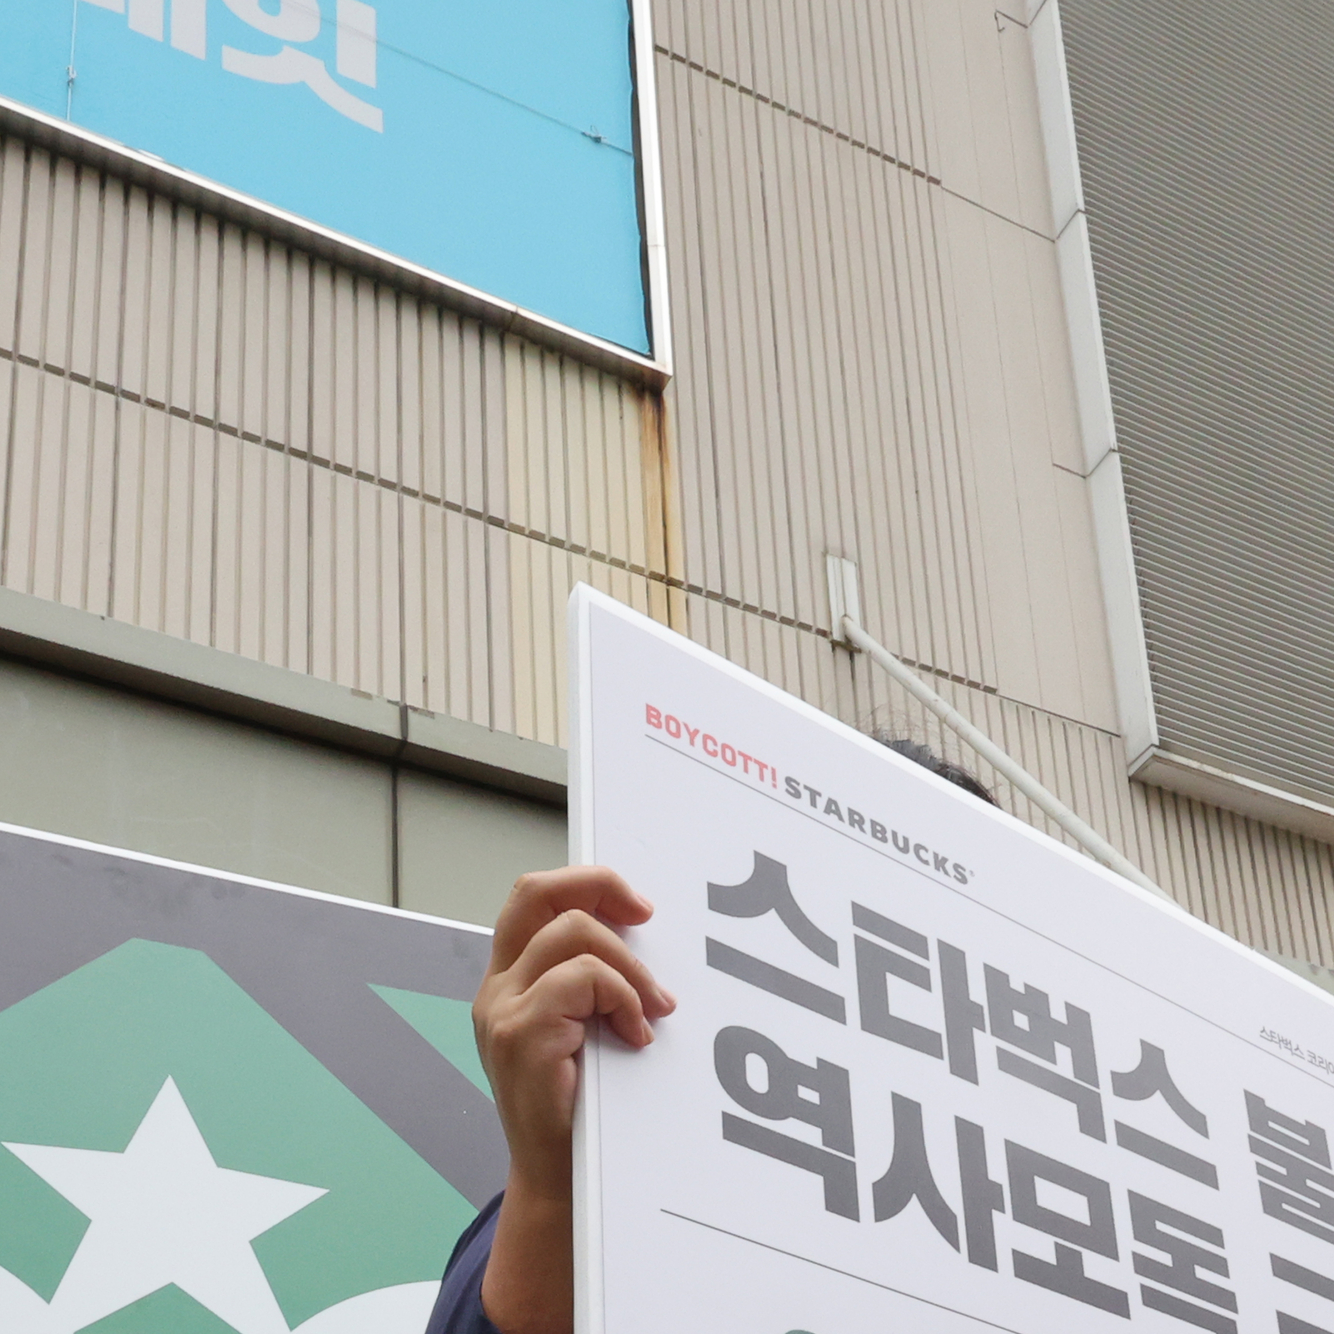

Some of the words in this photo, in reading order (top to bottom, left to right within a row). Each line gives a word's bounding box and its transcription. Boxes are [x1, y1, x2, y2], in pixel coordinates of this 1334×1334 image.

[645, 703, 778, 789] BOYCOTT!
[784, 775, 969, 885] STARBUCKS
[705, 849, 1220, 1191] 스타벅스
[1259, 1025, 1306, 1060] 스타벅스
